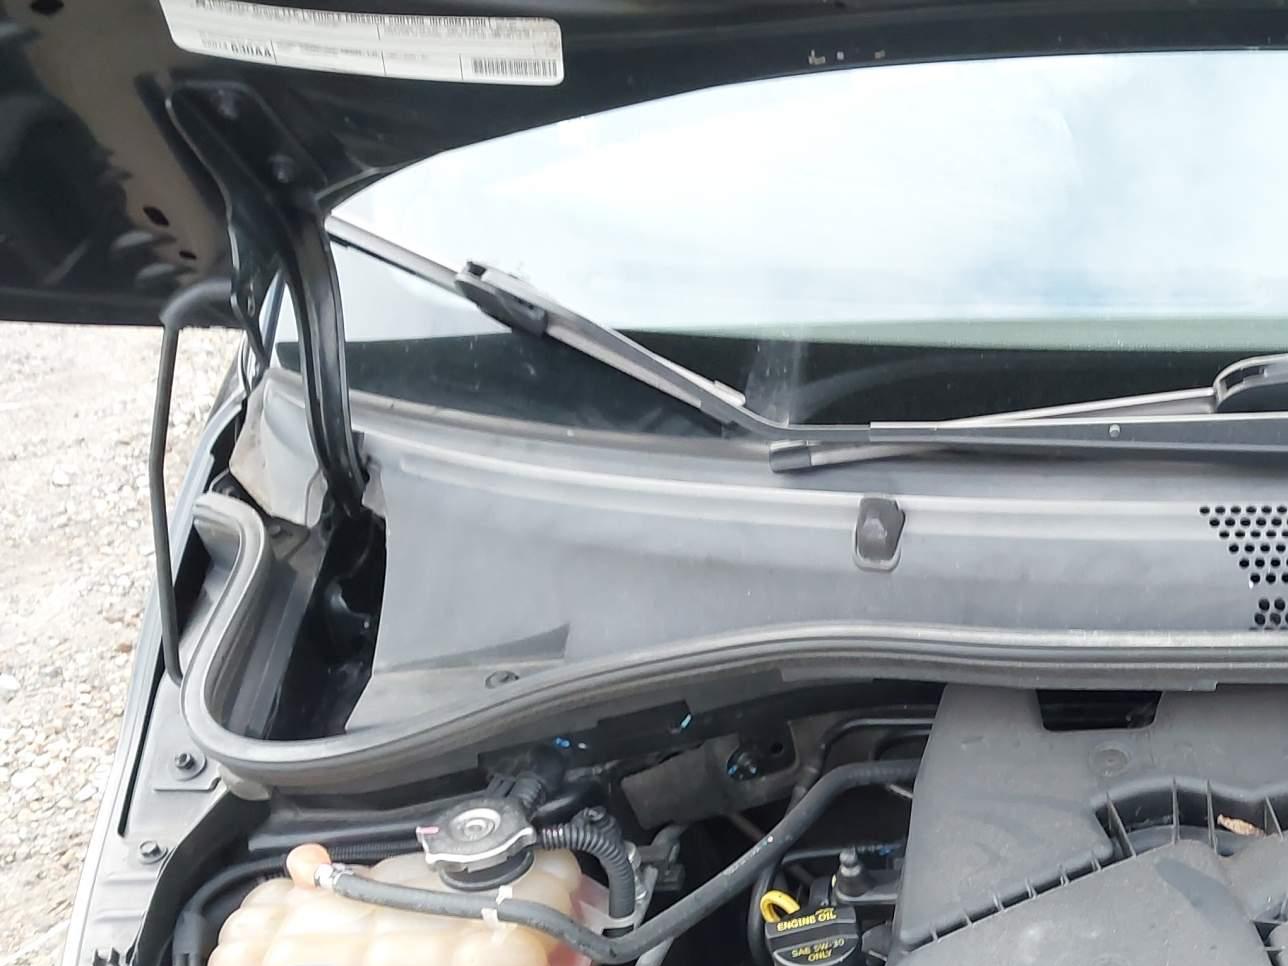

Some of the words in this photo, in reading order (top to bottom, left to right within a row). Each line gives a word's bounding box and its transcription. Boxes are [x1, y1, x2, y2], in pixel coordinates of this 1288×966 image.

[777, 915, 816, 932] ENGINE
[818, 909, 837, 921] OIL
[791, 948, 811, 958] SAE
[808, 950, 833, 962] ONLY
